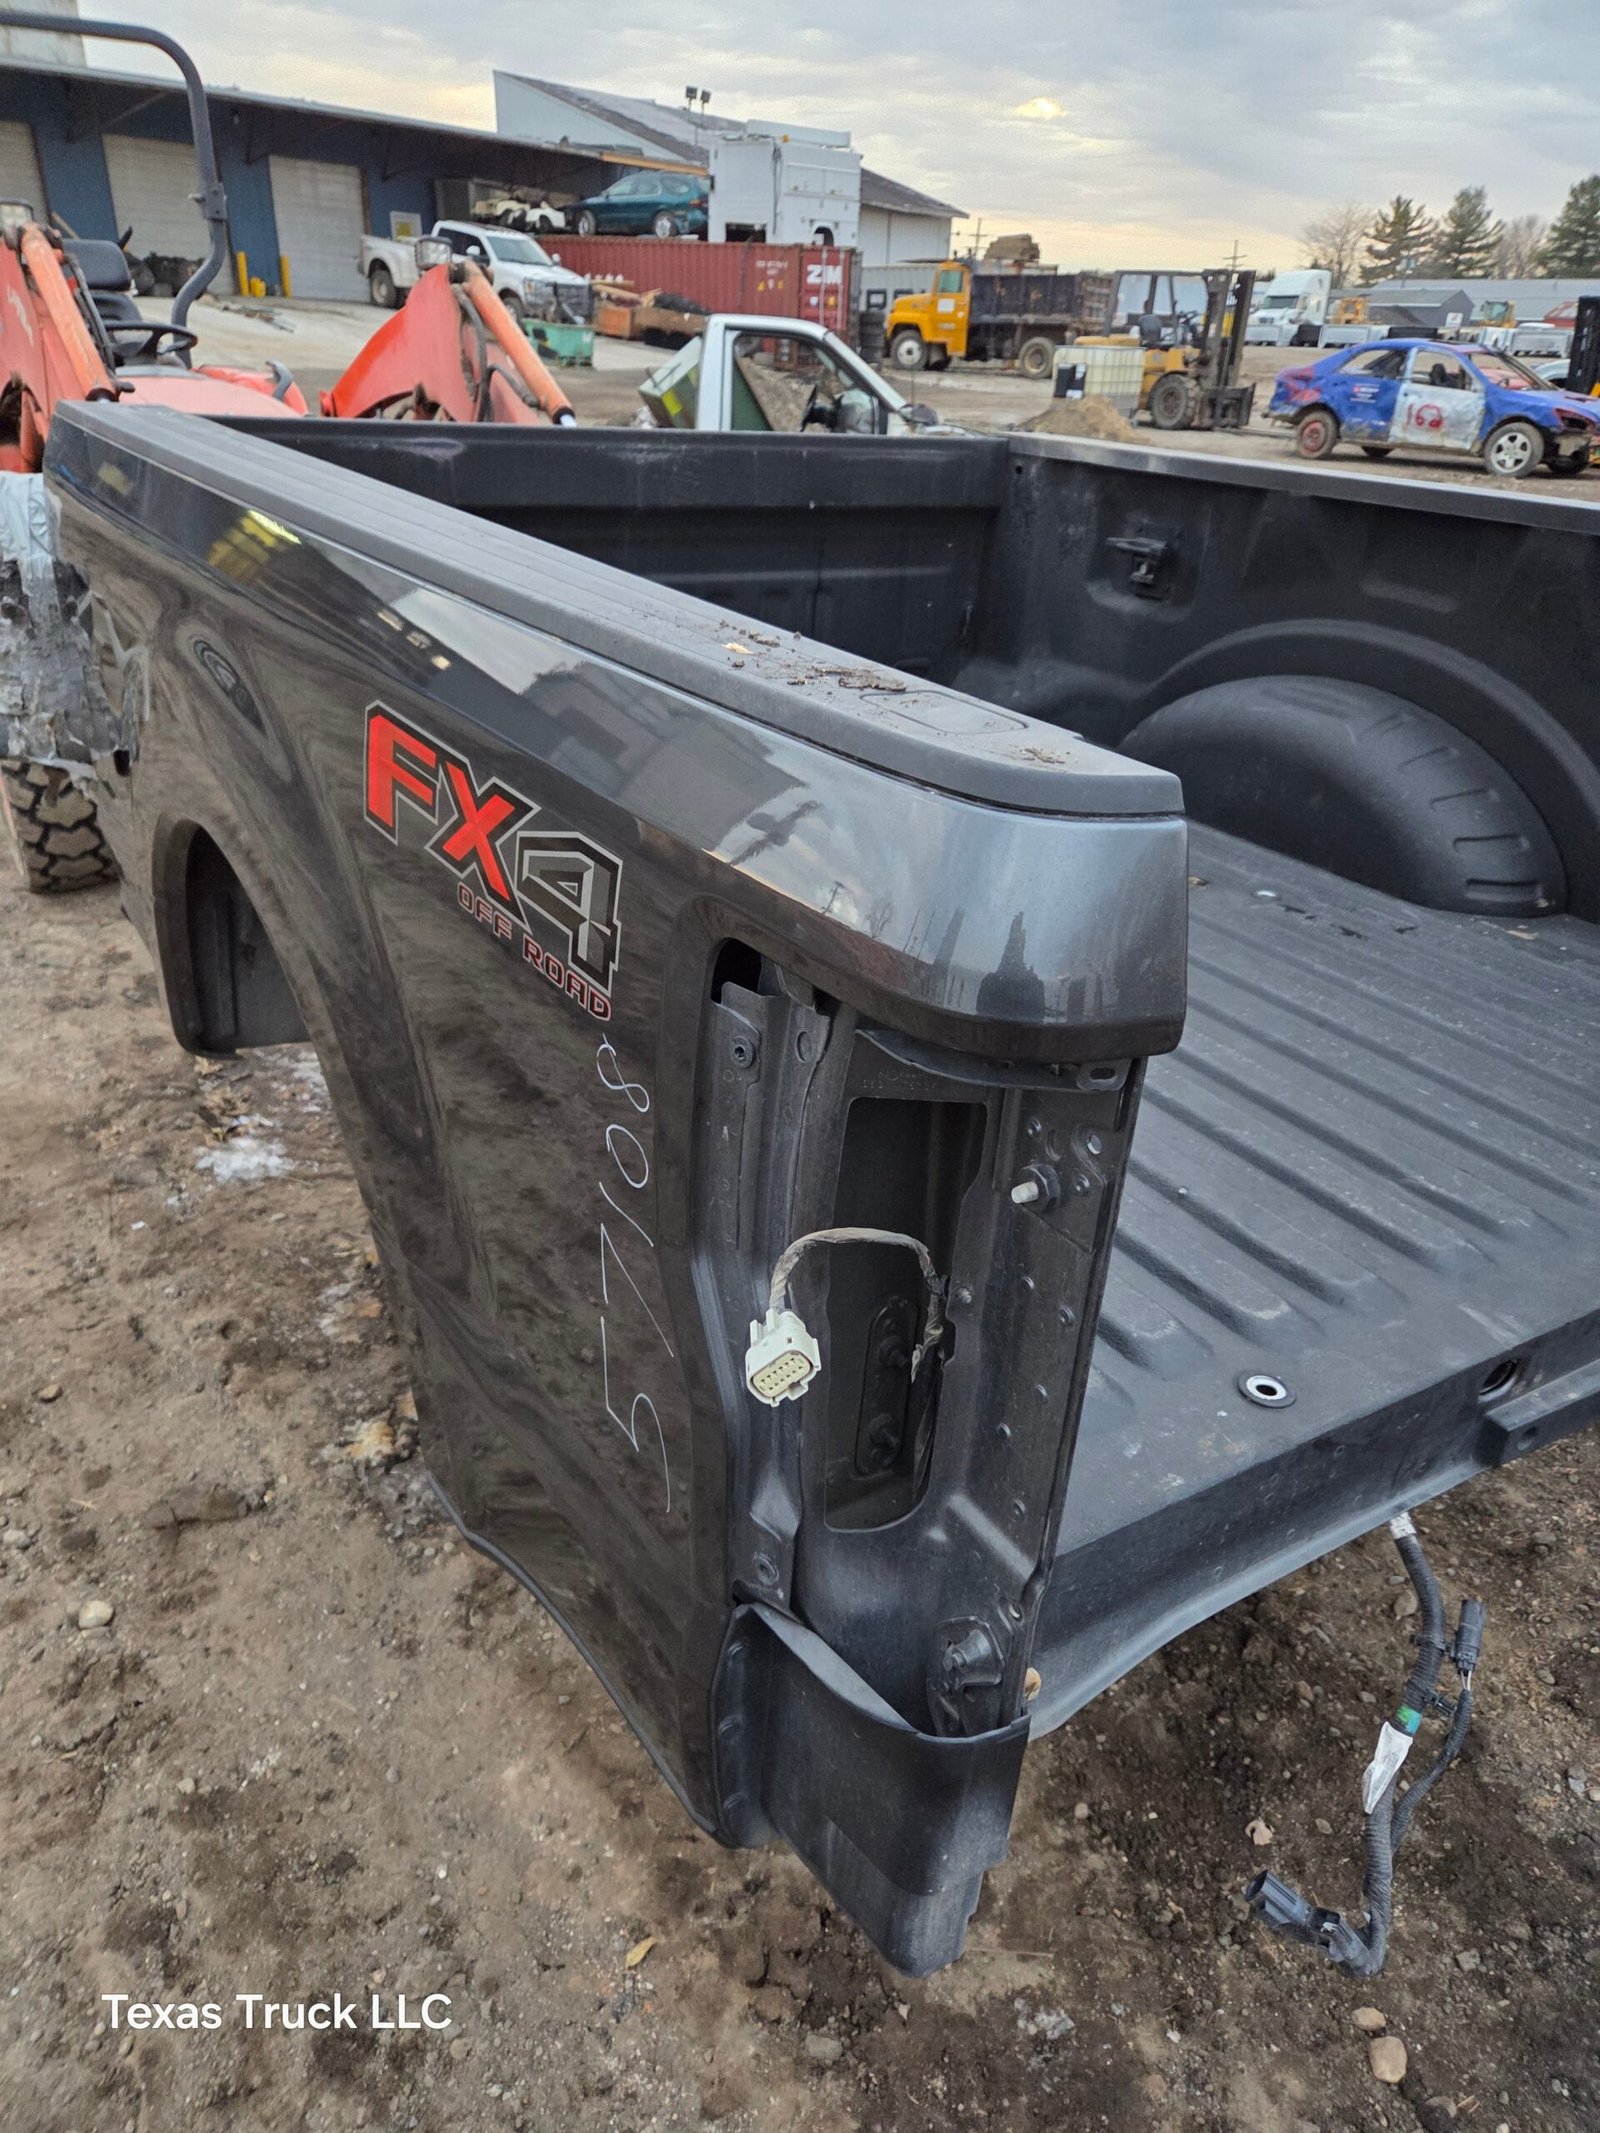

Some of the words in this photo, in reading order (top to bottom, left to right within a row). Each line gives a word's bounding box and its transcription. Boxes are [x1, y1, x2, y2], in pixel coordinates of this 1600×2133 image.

[364, 700, 623, 996] FX4
[457, 881, 512, 940] OFF
[523, 934, 611, 1021] ROAD
[597, 1033, 674, 1513] 57108
